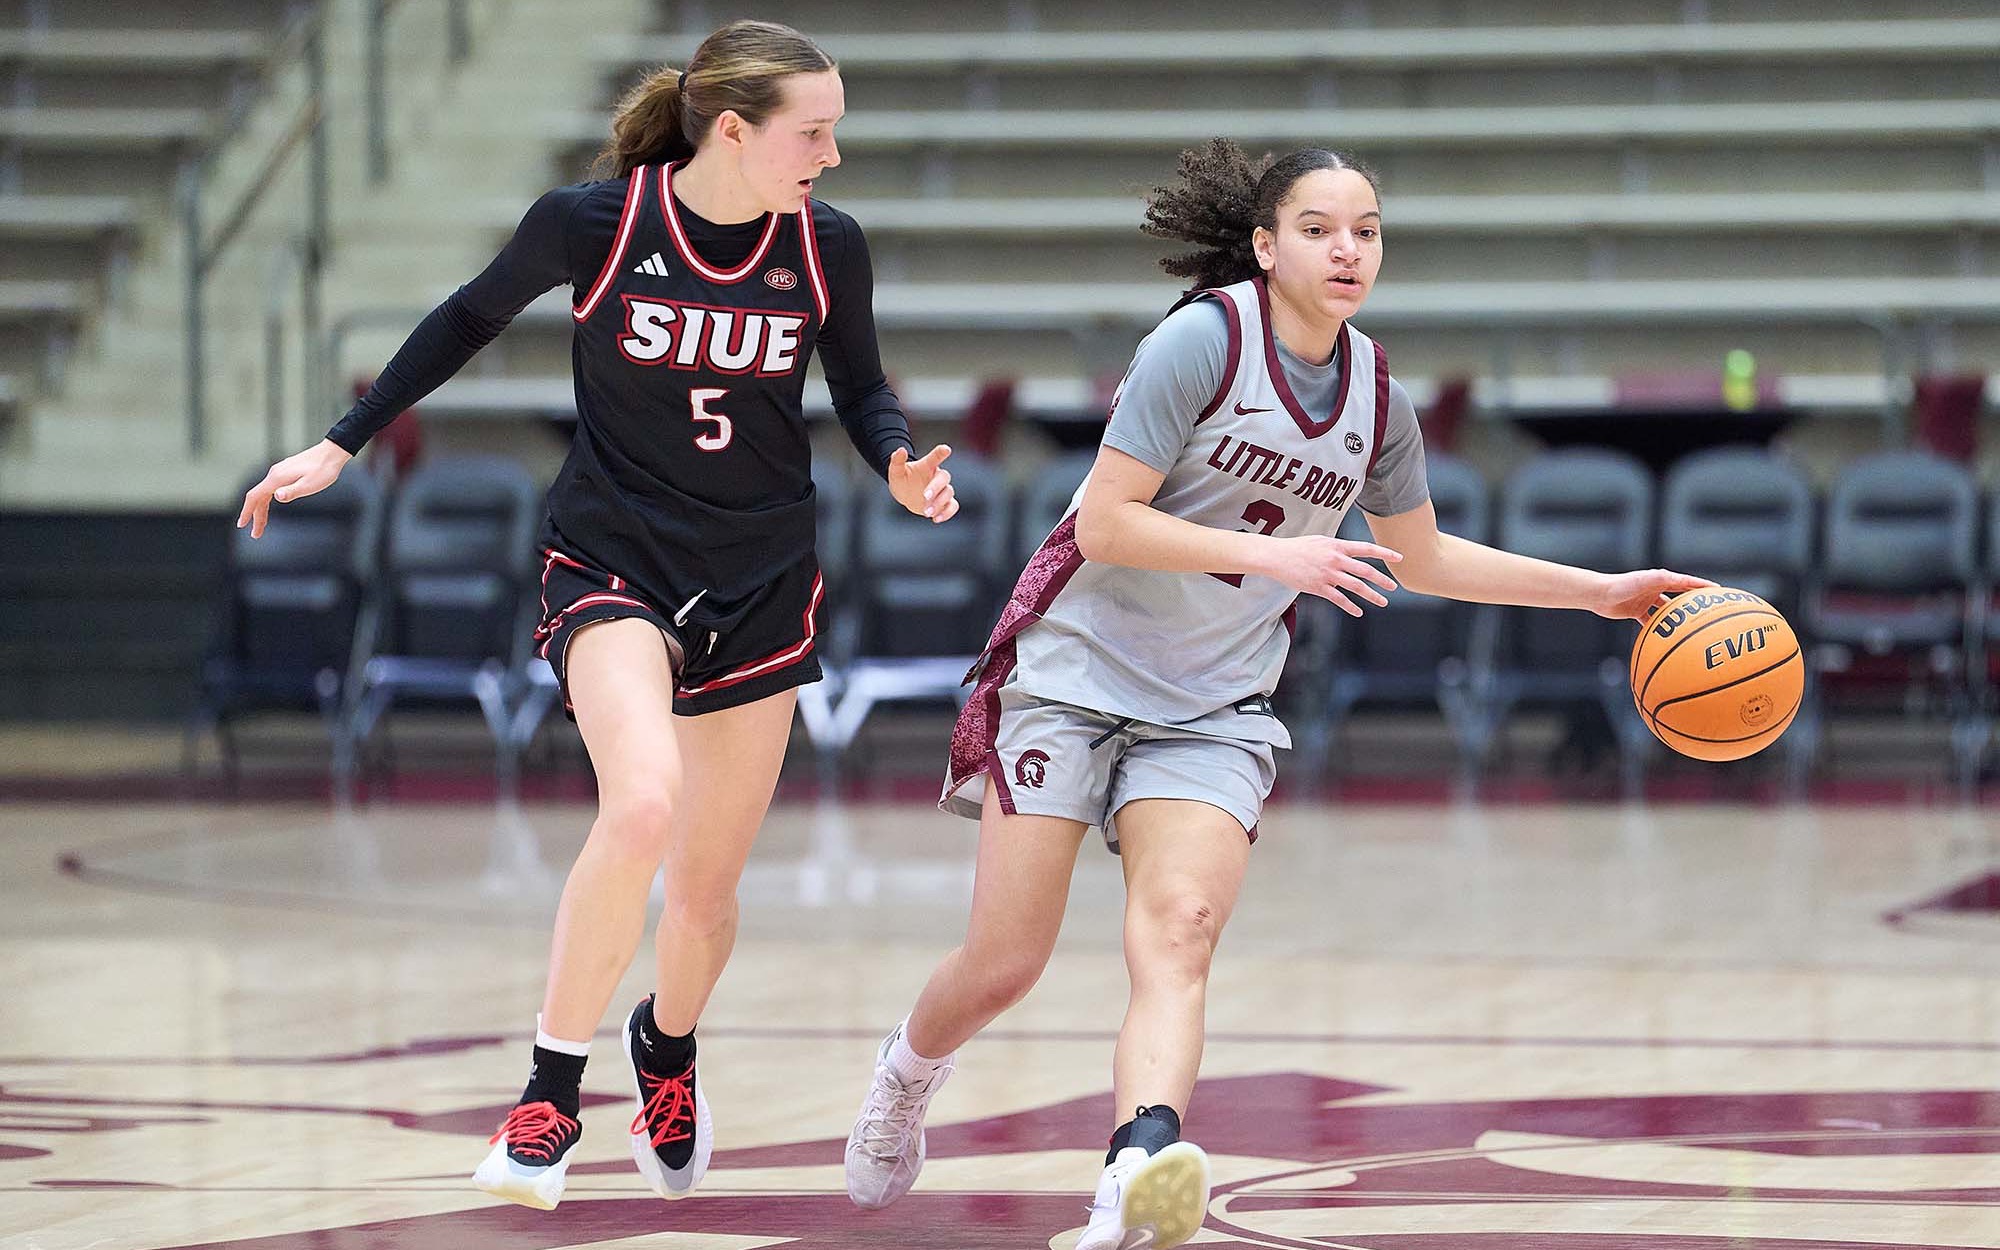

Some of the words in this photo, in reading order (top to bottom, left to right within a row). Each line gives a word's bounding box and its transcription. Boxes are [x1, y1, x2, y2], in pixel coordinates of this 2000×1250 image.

[618, 296, 807, 376] SIUE
[689, 388, 733, 453] 5
[1207, 434, 1303, 490] LITTLE
[1292, 465, 1357, 511] ROCK
[1652, 591, 1763, 638] Wilson
[1705, 628, 1765, 670] EVO
